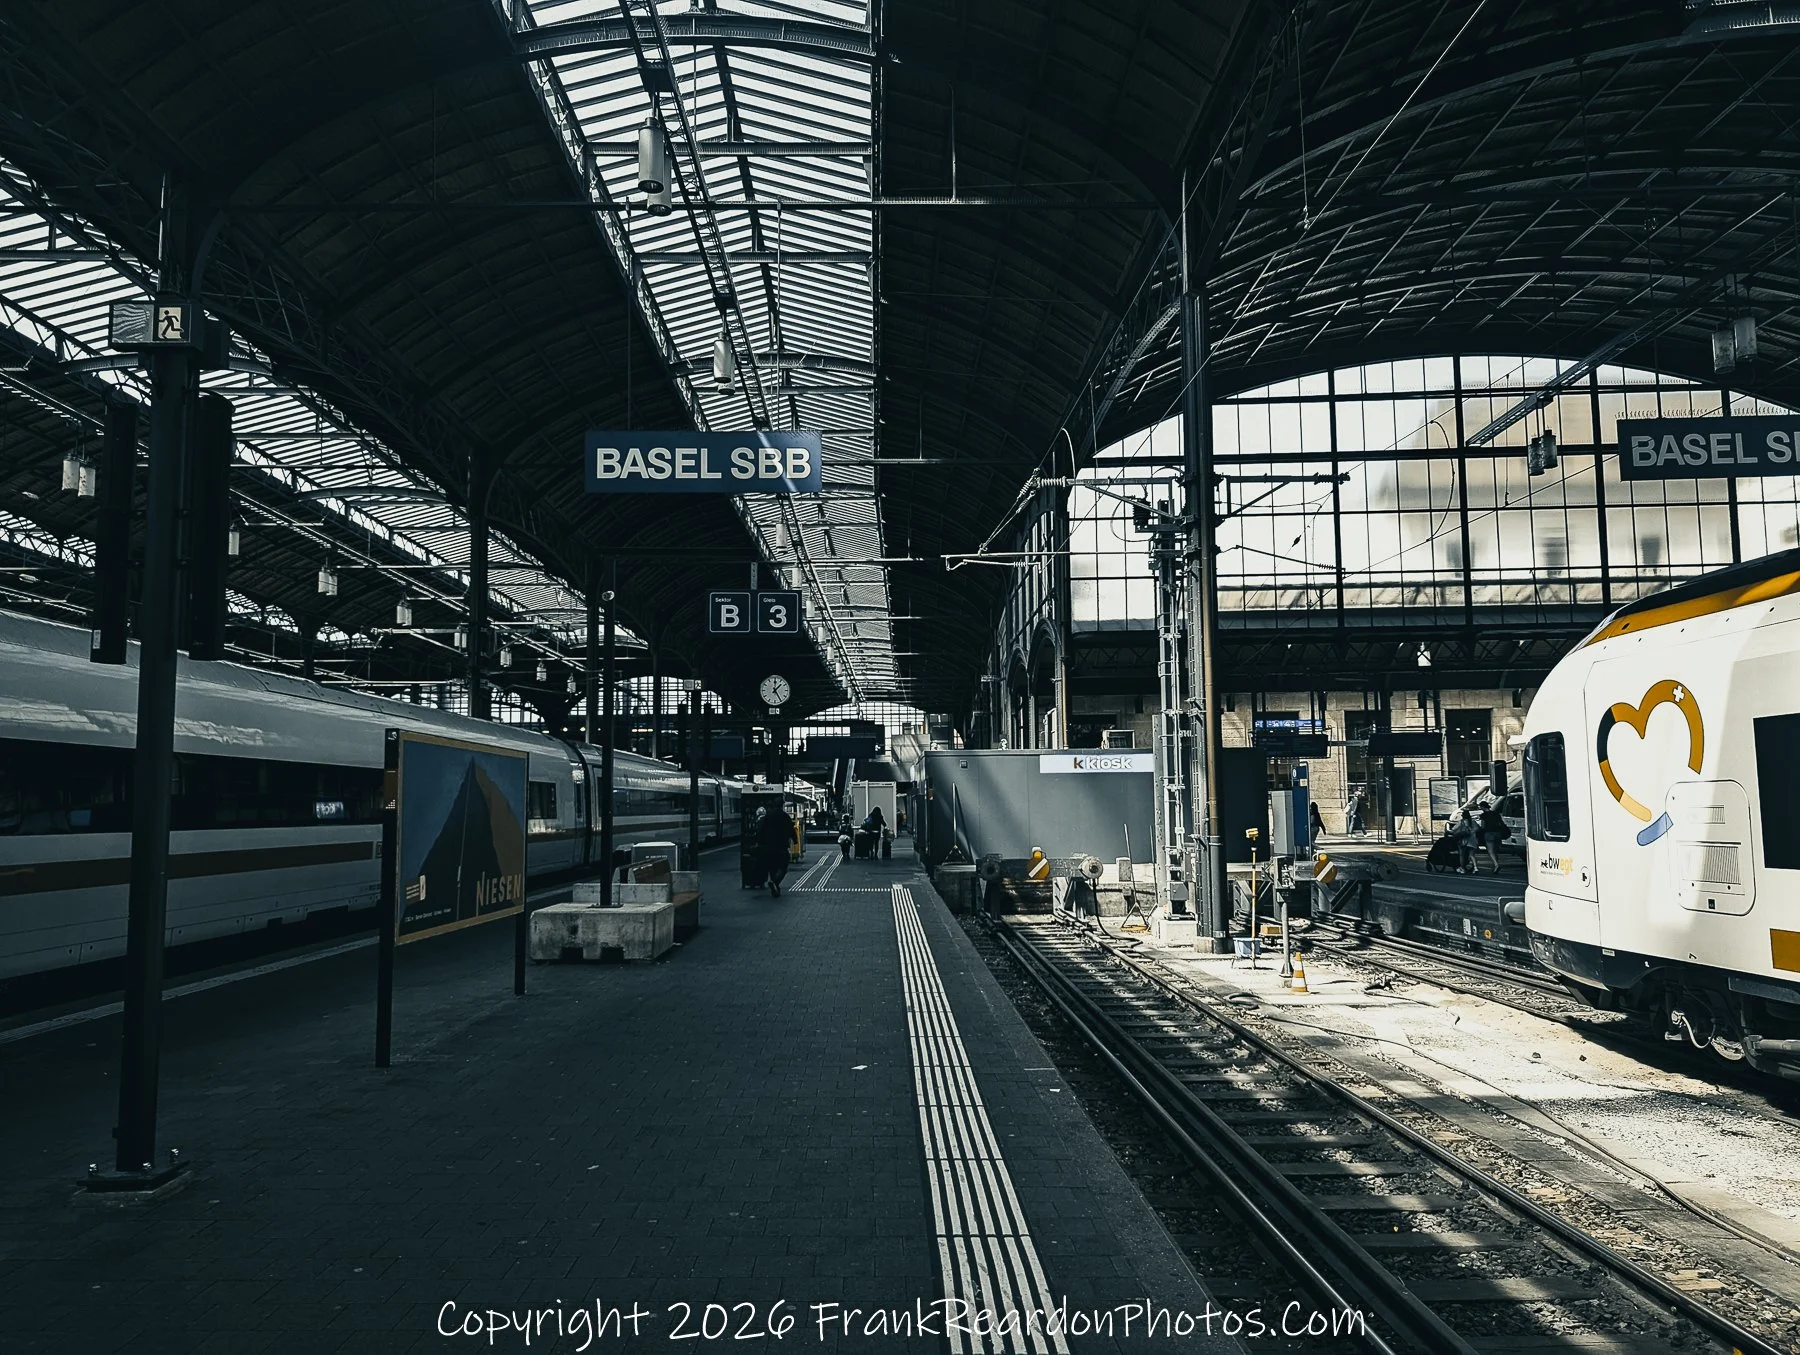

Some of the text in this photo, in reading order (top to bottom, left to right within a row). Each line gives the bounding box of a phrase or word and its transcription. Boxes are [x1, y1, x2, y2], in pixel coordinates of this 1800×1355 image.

[596, 447, 811, 479] BASEL SBB
[1631, 433, 1758, 467] BASEL
[721, 604, 740, 627] B
[769, 604, 787, 628] 3
[1086, 755, 1132, 770] kiosk
[476, 872, 521, 917] NIESEN
